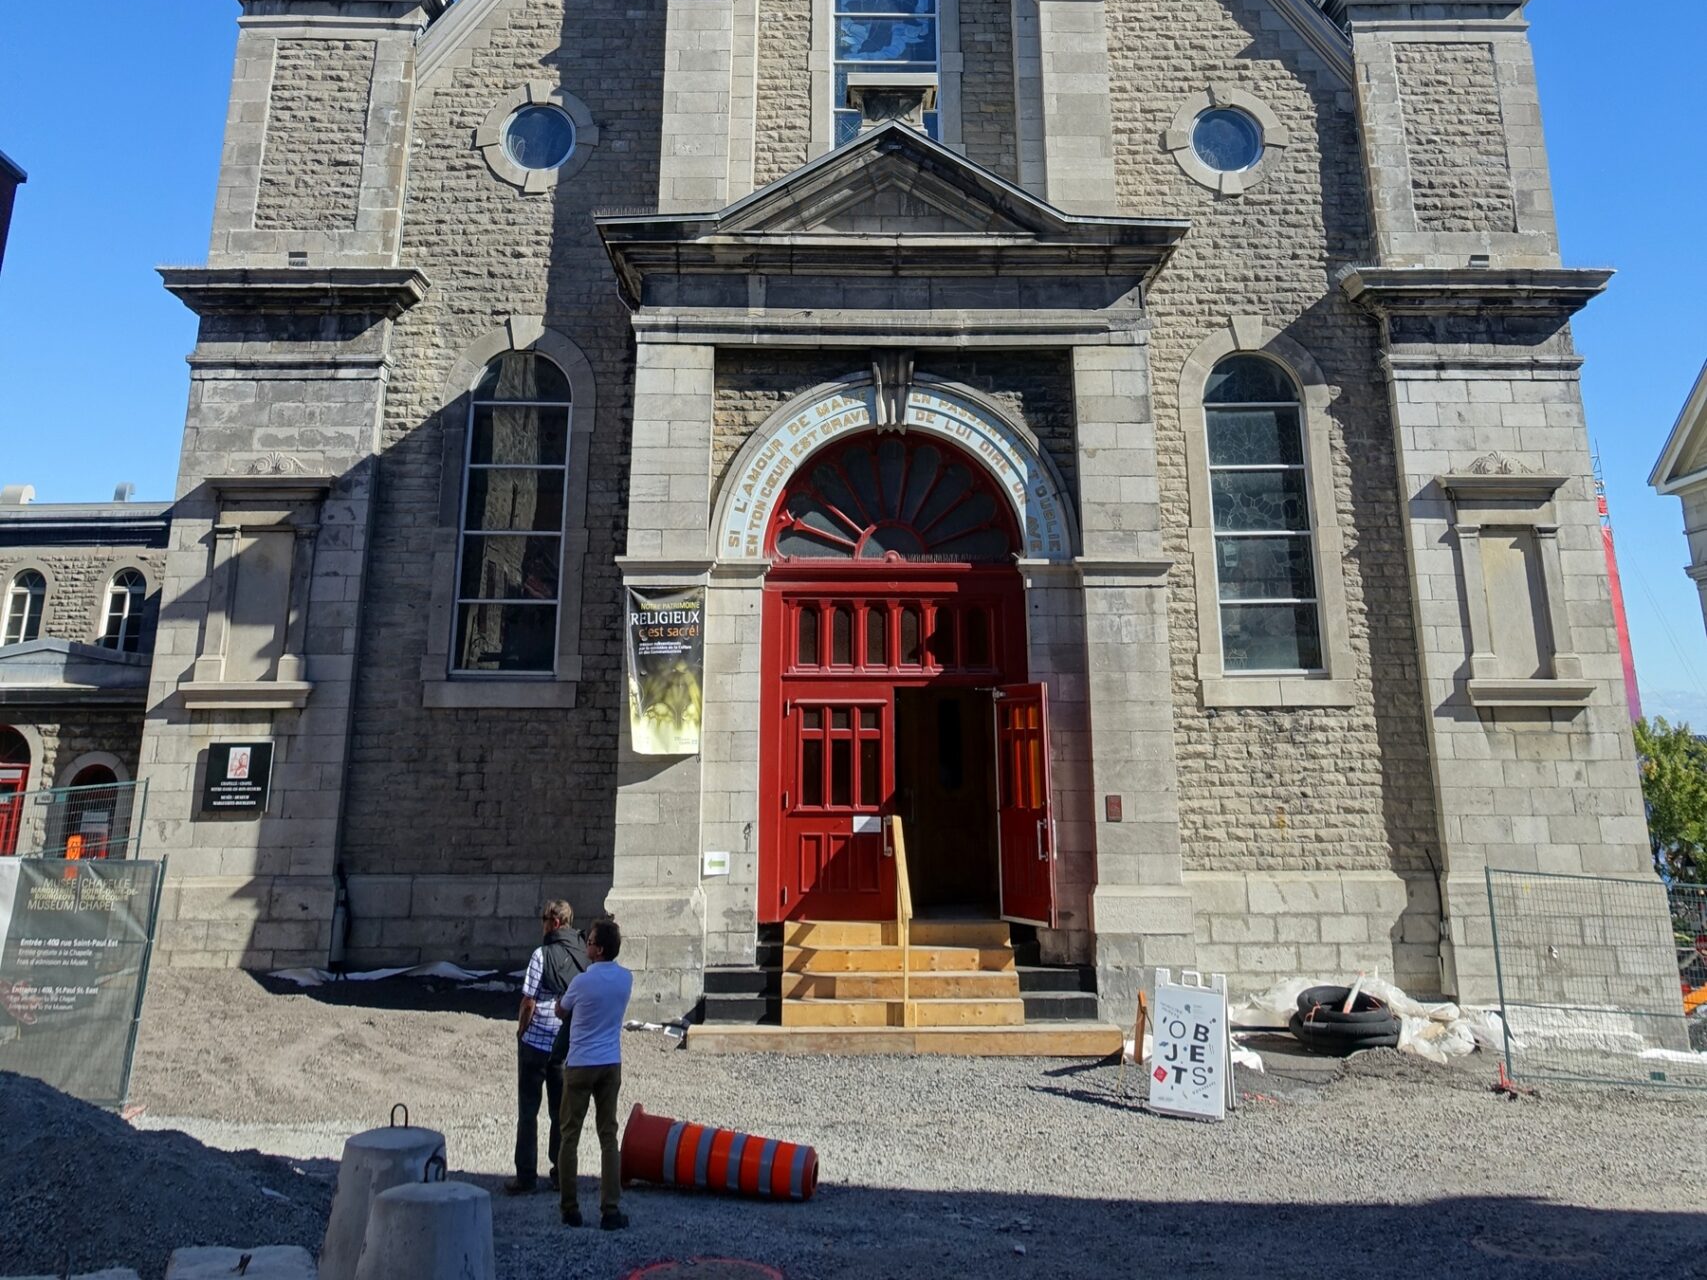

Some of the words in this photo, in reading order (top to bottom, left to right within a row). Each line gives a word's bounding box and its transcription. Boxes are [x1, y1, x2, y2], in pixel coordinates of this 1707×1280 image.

[815, 390, 867, 417] MARIE
[787, 414, 812, 436] DE
[790, 430, 817, 458] EST
[734, 438, 783, 513] L'AMOUR
[760, 455, 793, 498] CŒUR
[912, 392, 932, 405] EN
[938, 399, 1007, 444] PASSANT
[1008, 443, 1028, 467] NE
[1028, 468, 1061, 552] T'OUBLIE
[915, 409, 937, 424] DE
[944, 421, 973, 441] LUI
[978, 439, 1012, 476] DIRE
[1012, 482, 1029, 506] UN
[1027, 515, 1043, 552] AVE
[749, 500, 767, 531] TON
[728, 529, 741, 548] SI
[746, 534, 759, 557] EN
[641, 602, 661, 610] NOTRE
[662, 601, 700, 609] PATRIMOINE
[630, 611, 700, 625] RELIGIEUX
[639, 625, 664, 638] c'est
[667, 624, 699, 637] sacré!
[81, 879, 132, 889] CHAPELLE
[27, 900, 75, 911] MUSEUM
[78, 901, 117, 911] CHAPEL
[20, 937, 42, 946] Entrée
[47, 938, 60, 946] 400
[73, 938, 107, 947] Saint-Paul
